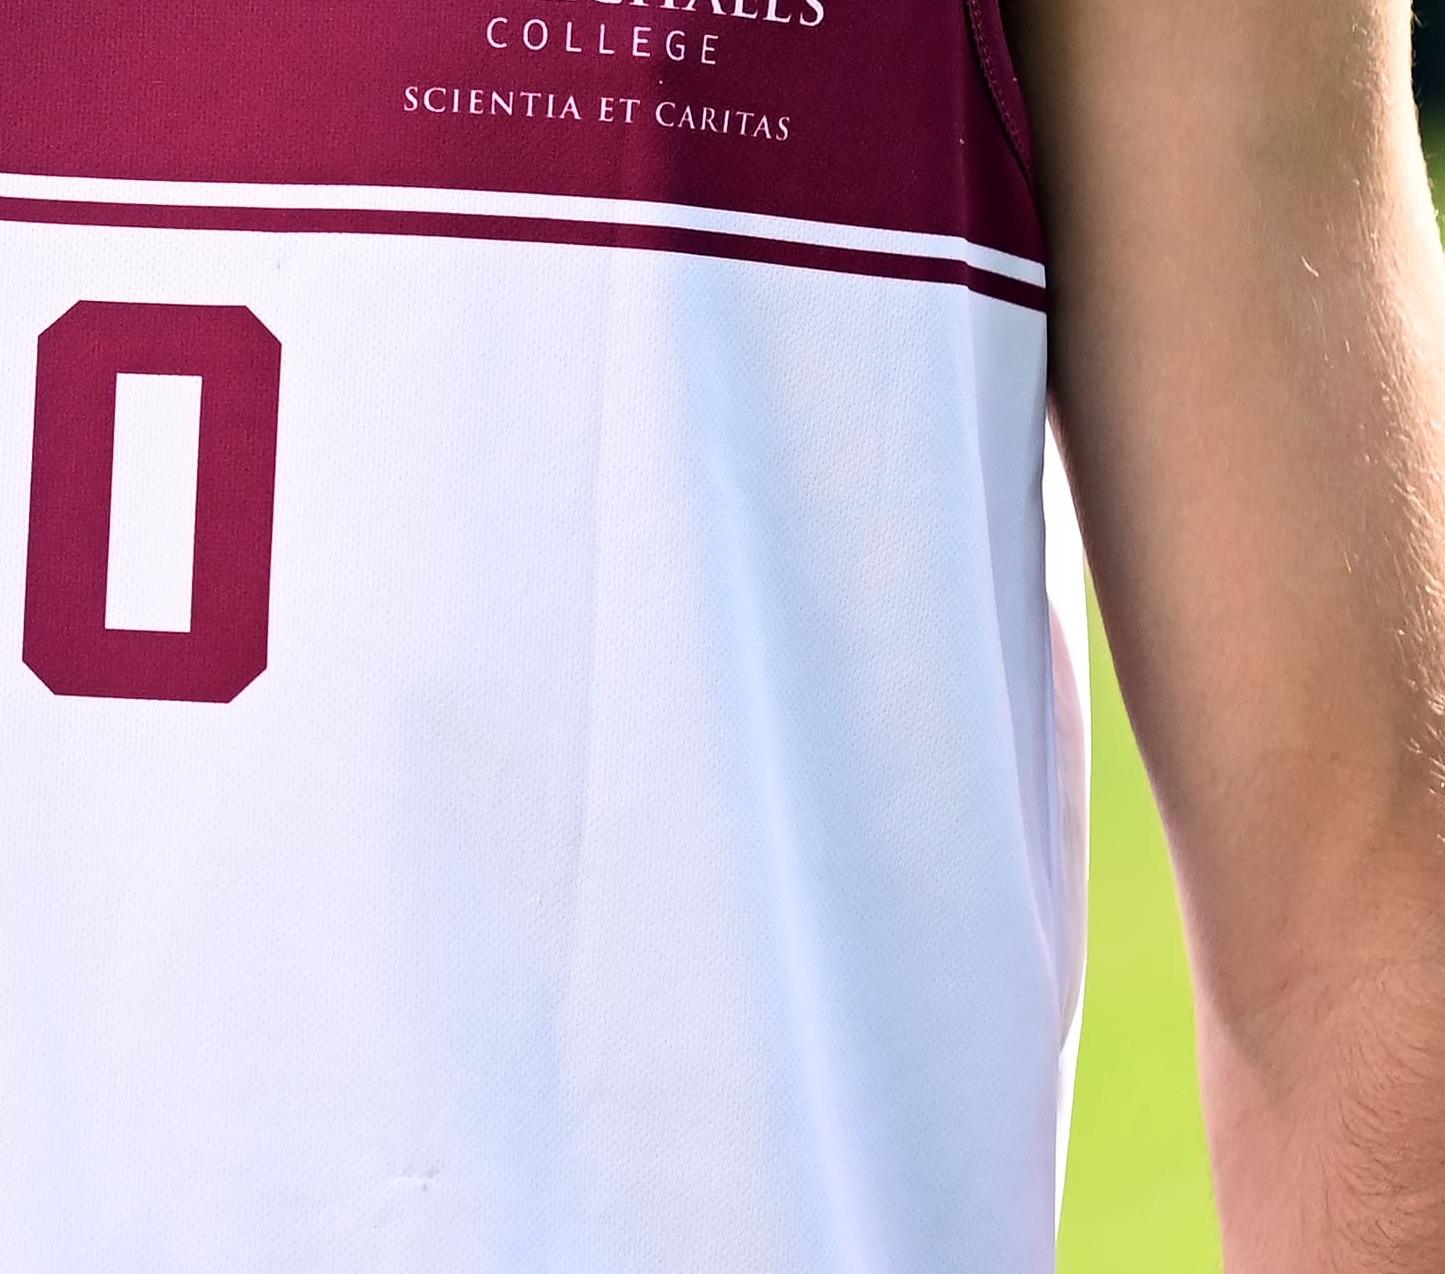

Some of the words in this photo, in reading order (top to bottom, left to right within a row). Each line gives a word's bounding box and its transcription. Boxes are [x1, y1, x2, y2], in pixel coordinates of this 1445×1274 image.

[486, 17, 719, 65] COLLEGE
[403, 86, 582, 120] SCIENTIA
[599, 97, 641, 124] ET
[655, 101, 791, 141] CARITAS
